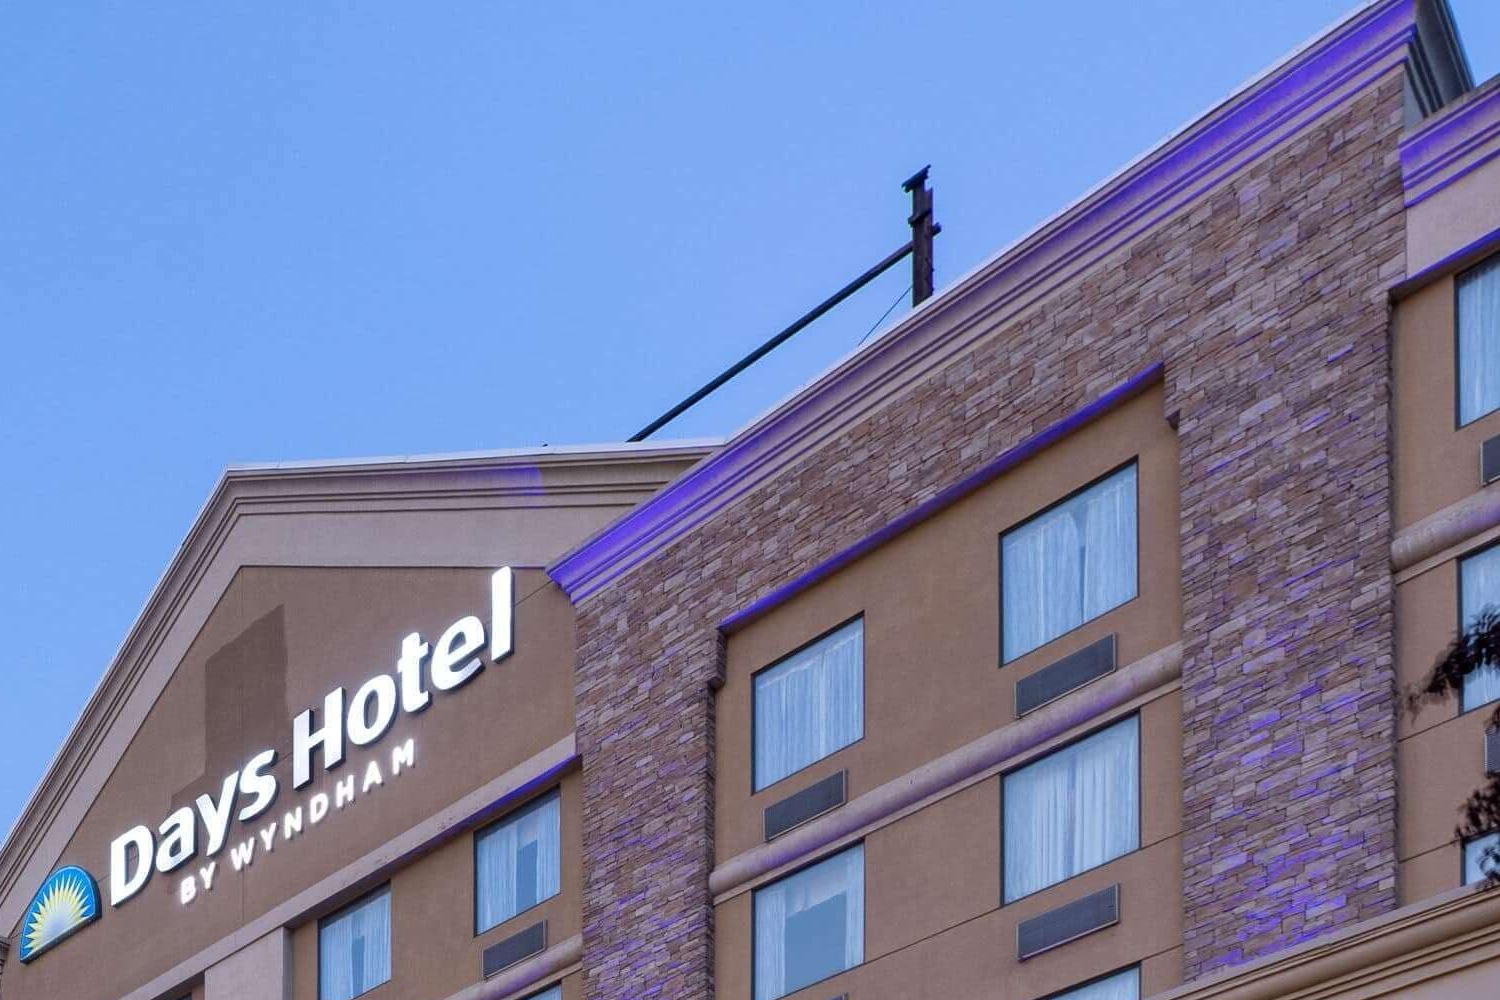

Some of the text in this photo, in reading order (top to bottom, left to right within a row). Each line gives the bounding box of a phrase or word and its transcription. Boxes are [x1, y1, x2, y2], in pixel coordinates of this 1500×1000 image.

[111, 567, 514, 908] Days Hotel
[179, 738, 415, 905] BY WYNDHAM
